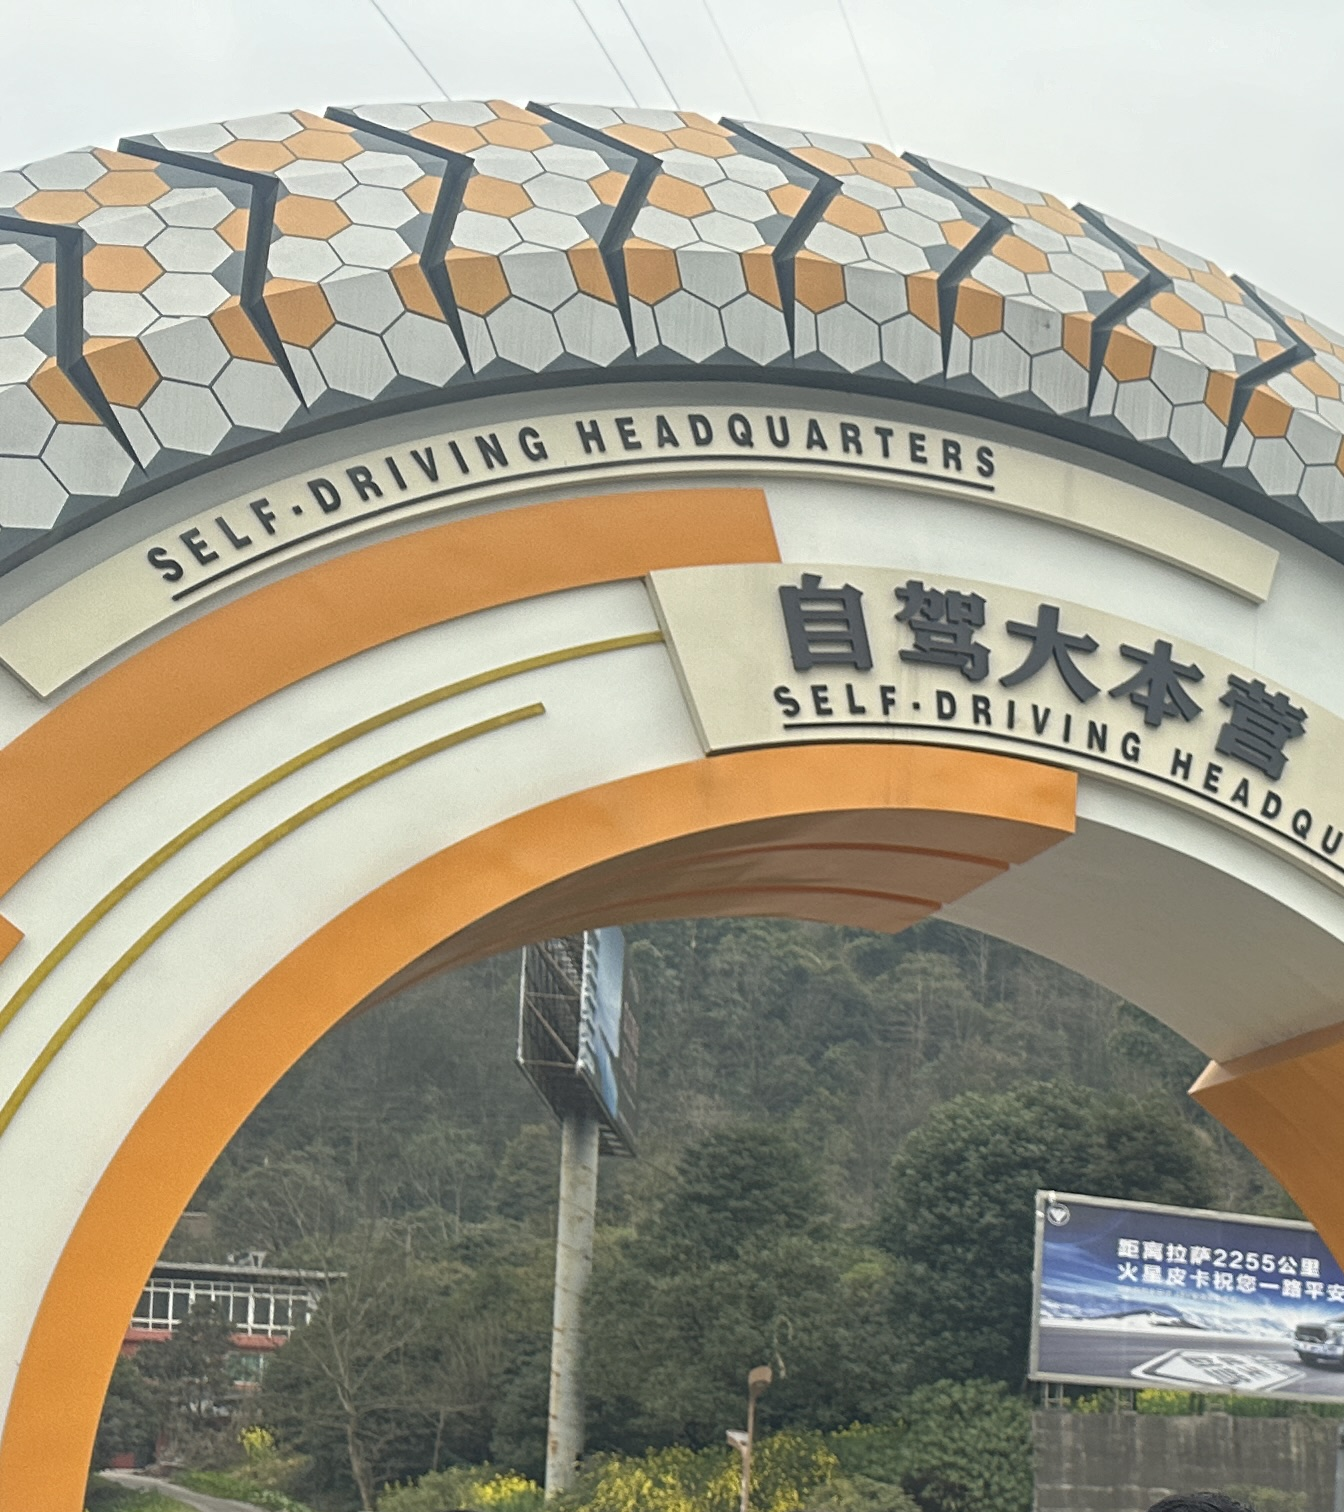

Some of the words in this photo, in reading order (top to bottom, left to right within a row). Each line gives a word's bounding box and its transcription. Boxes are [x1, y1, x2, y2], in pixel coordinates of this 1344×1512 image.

[575, 414, 996, 478] HEADQUARTERS
[779, 573, 1307, 783] 自驾大本营
[1118, 1238, 1321, 1278] 距离拉萨2255公里
